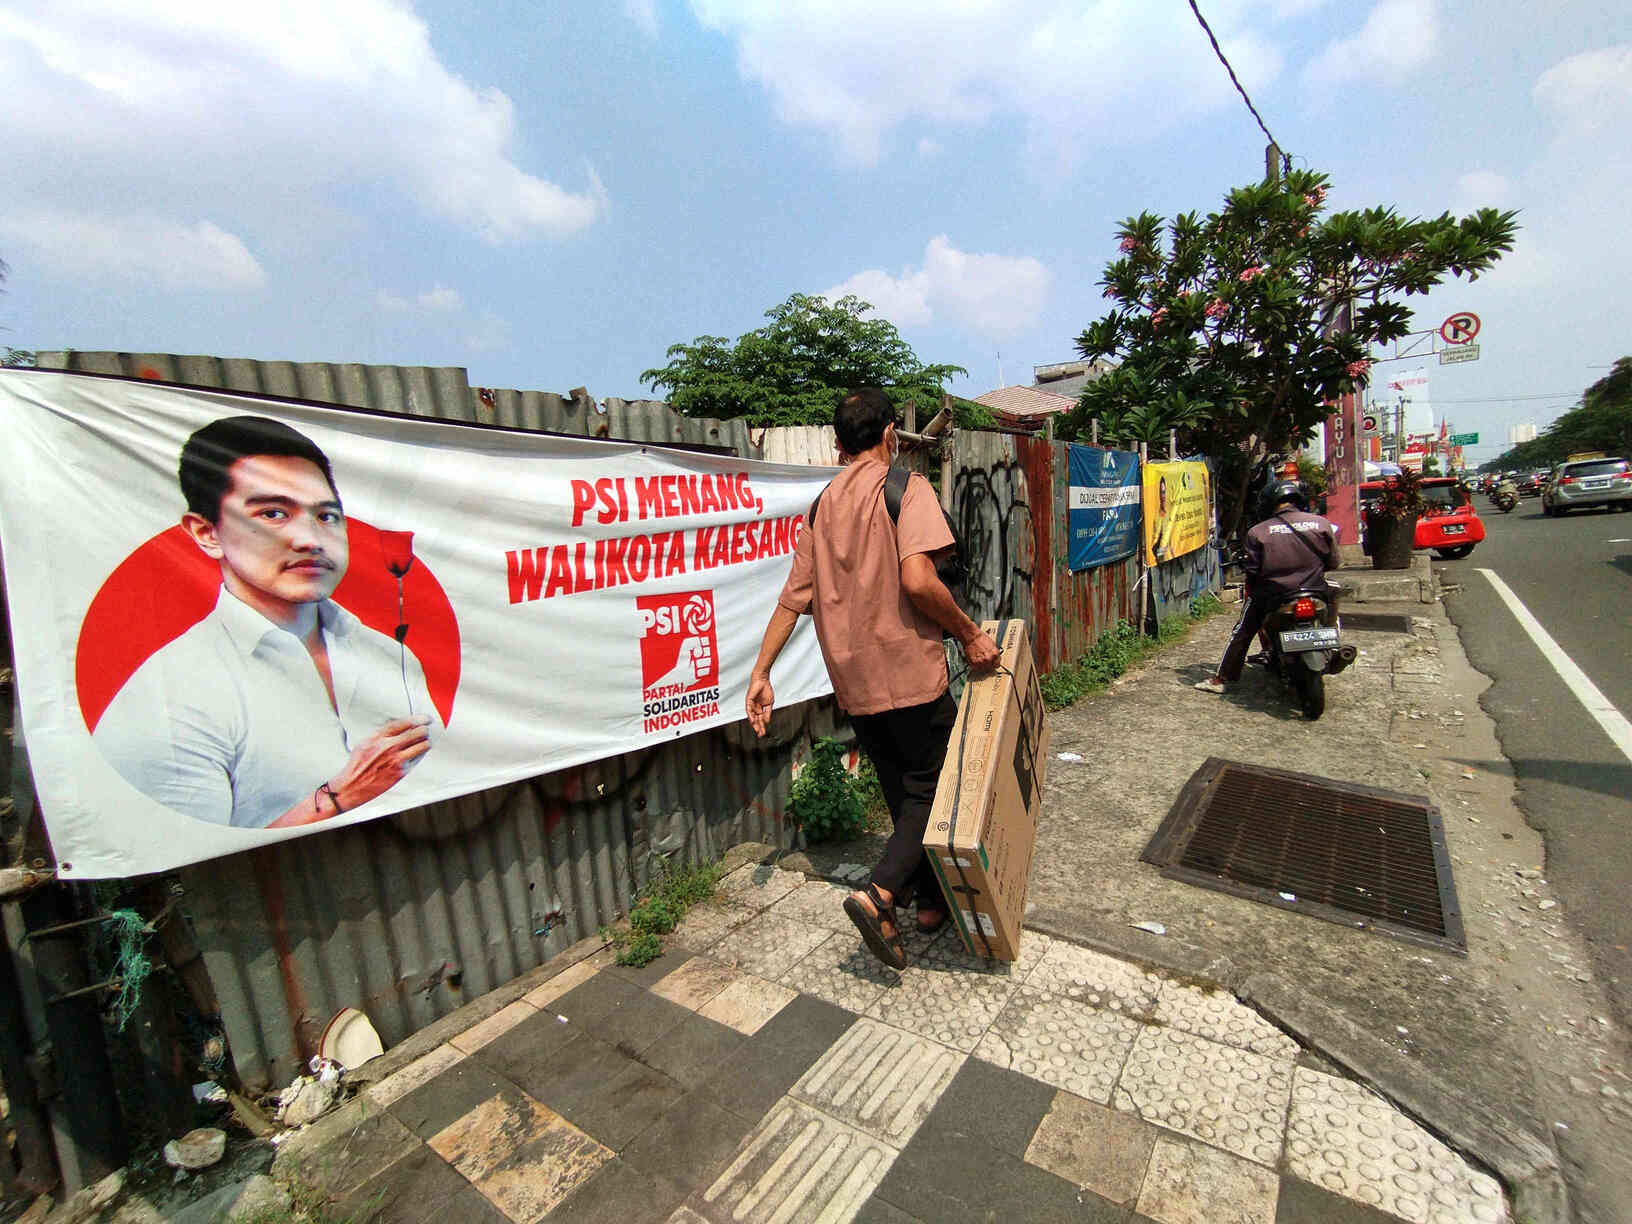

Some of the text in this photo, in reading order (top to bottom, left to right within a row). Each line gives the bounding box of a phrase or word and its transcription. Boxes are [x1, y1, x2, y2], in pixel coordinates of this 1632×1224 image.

[571, 473, 763, 527] PSI MENANG,
[504, 514, 803, 605] WALIKOTA KAESANG
[636, 604, 681, 638] PSI
[642, 682, 684, 703] PARTAI
[643, 687, 720, 718] SOLIDARITAS
[643, 702, 720, 734] INDONESIA
